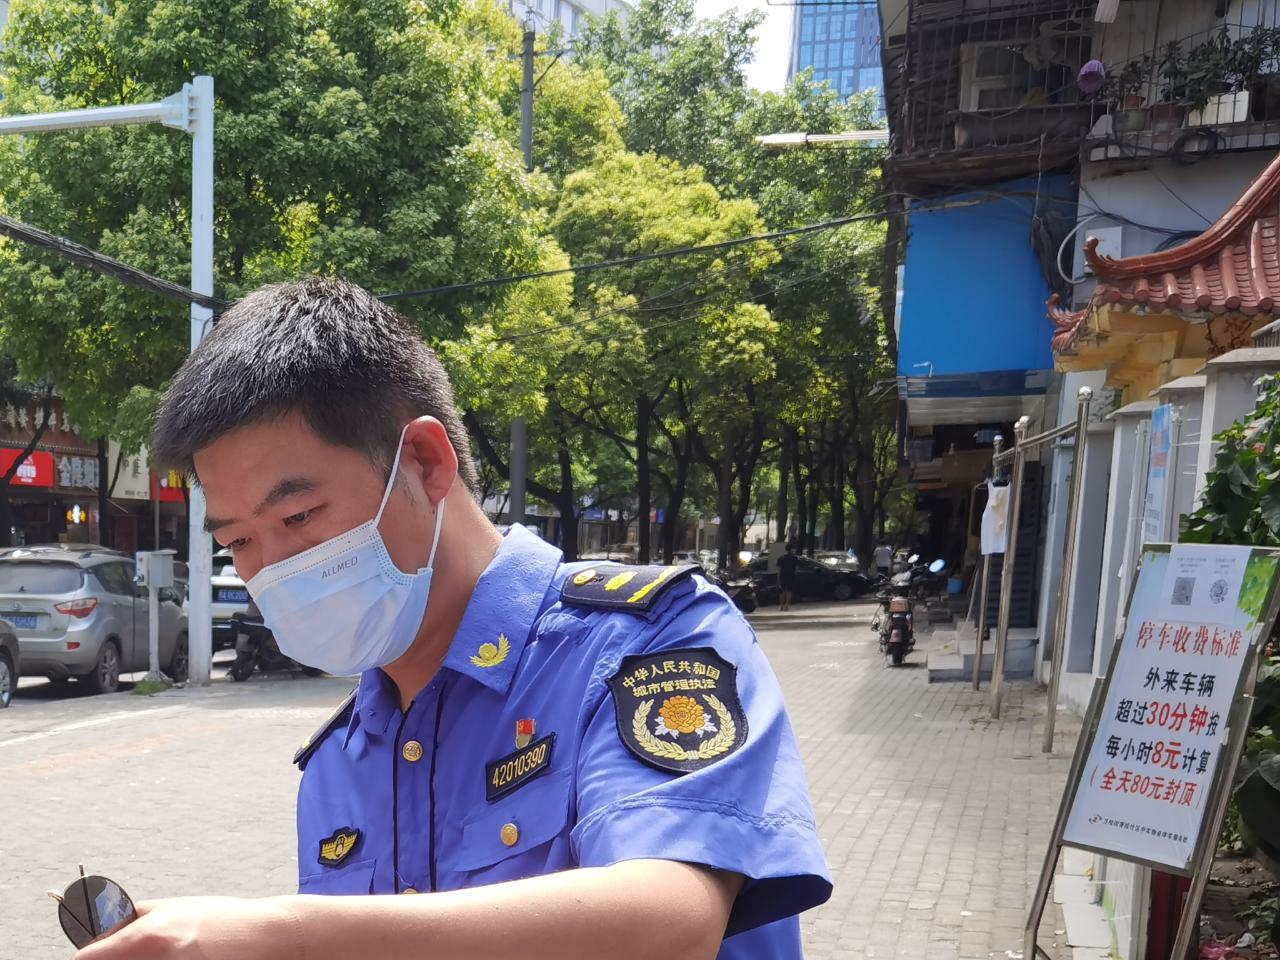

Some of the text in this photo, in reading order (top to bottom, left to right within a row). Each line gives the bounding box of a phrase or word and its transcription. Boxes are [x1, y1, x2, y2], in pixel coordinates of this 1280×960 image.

[321, 555, 359, 580] ALLMED
[1136, 621, 1243, 658] 停车收费标准
[622, 660, 720, 688] 中华人民共和国
[632, 678, 717, 698] 城市管理执法
[1144, 667, 1216, 697] 外来车辆
[1115, 699, 1220, 736] 超过30分钟按
[492, 743, 547, 788] 42010390
[1105, 735, 1211, 775] 每小时8元计算
